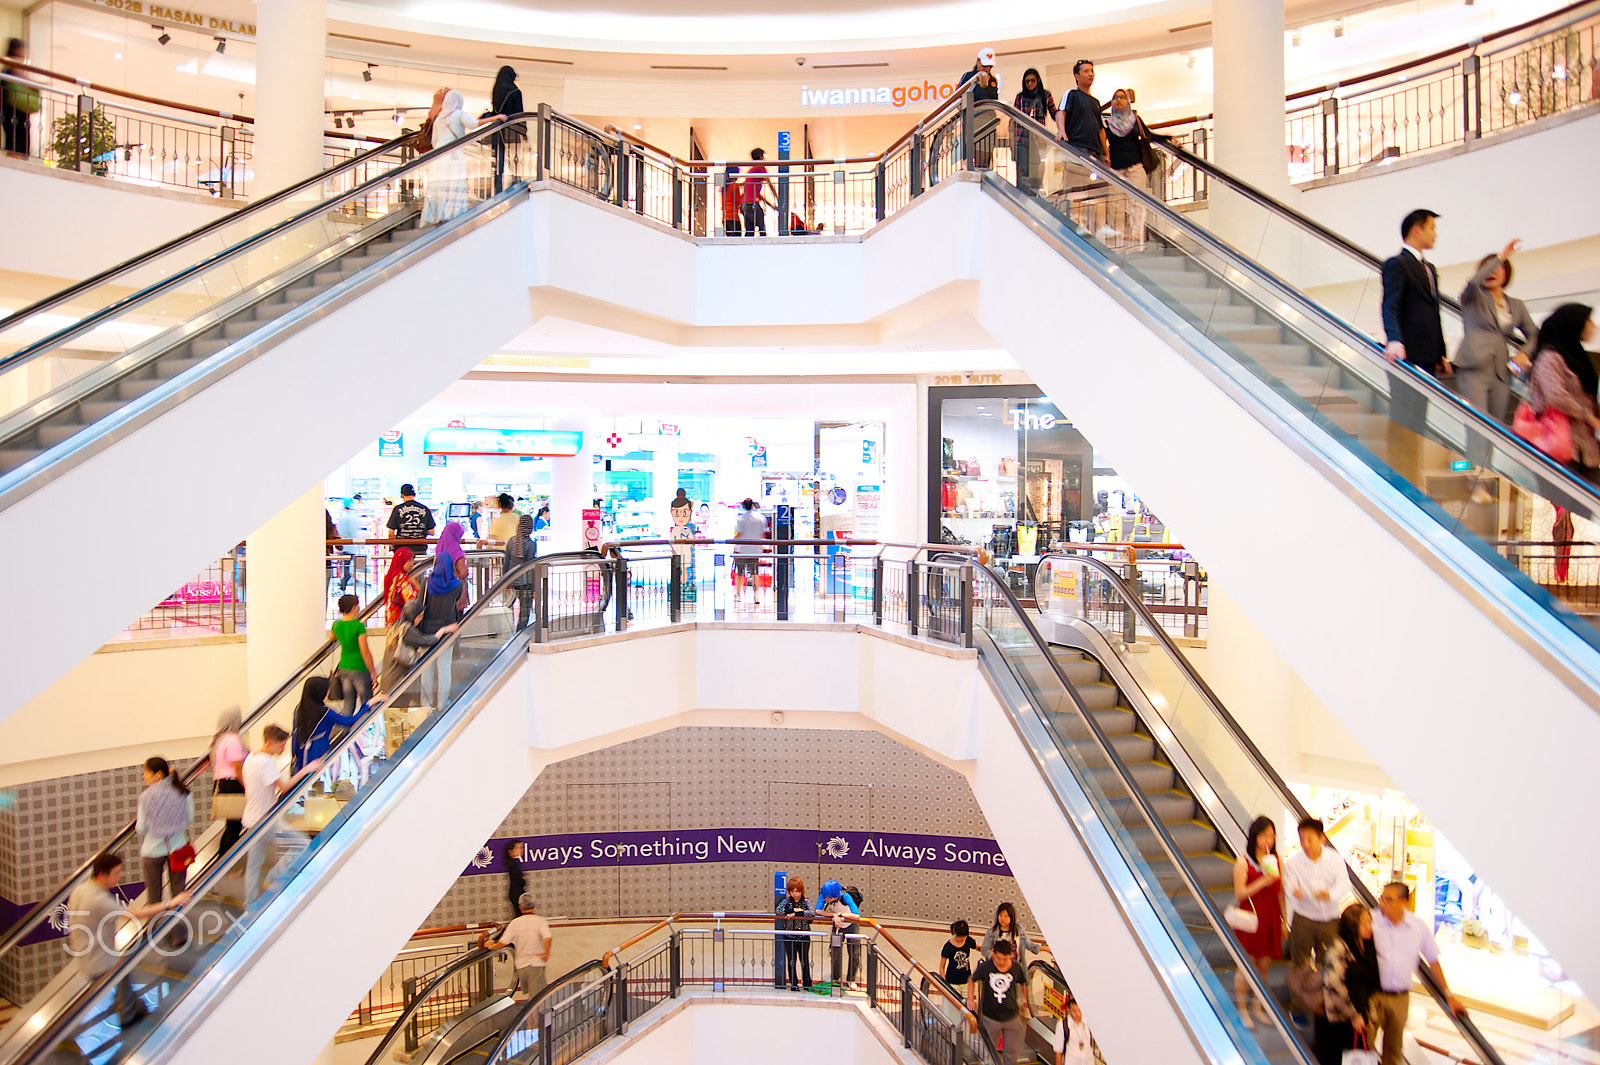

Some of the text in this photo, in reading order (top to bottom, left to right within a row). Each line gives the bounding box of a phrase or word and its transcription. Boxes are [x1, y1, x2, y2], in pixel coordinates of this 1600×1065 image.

[150, 4, 203, 26] HIASAN
[801, 79, 960, 108] iwannagoho
[781, 132, 790, 146] 3
[968, 373, 1002, 385] BUTIK
[1008, 407, 1056, 431] The
[404, 514, 421, 525] 25
[780, 505, 789, 519] 2
[186, 585, 232, 597] Kiss Me
[590, 836, 709, 859] Something
[717, 835, 766, 854] New
[861, 838, 937, 865] Always
